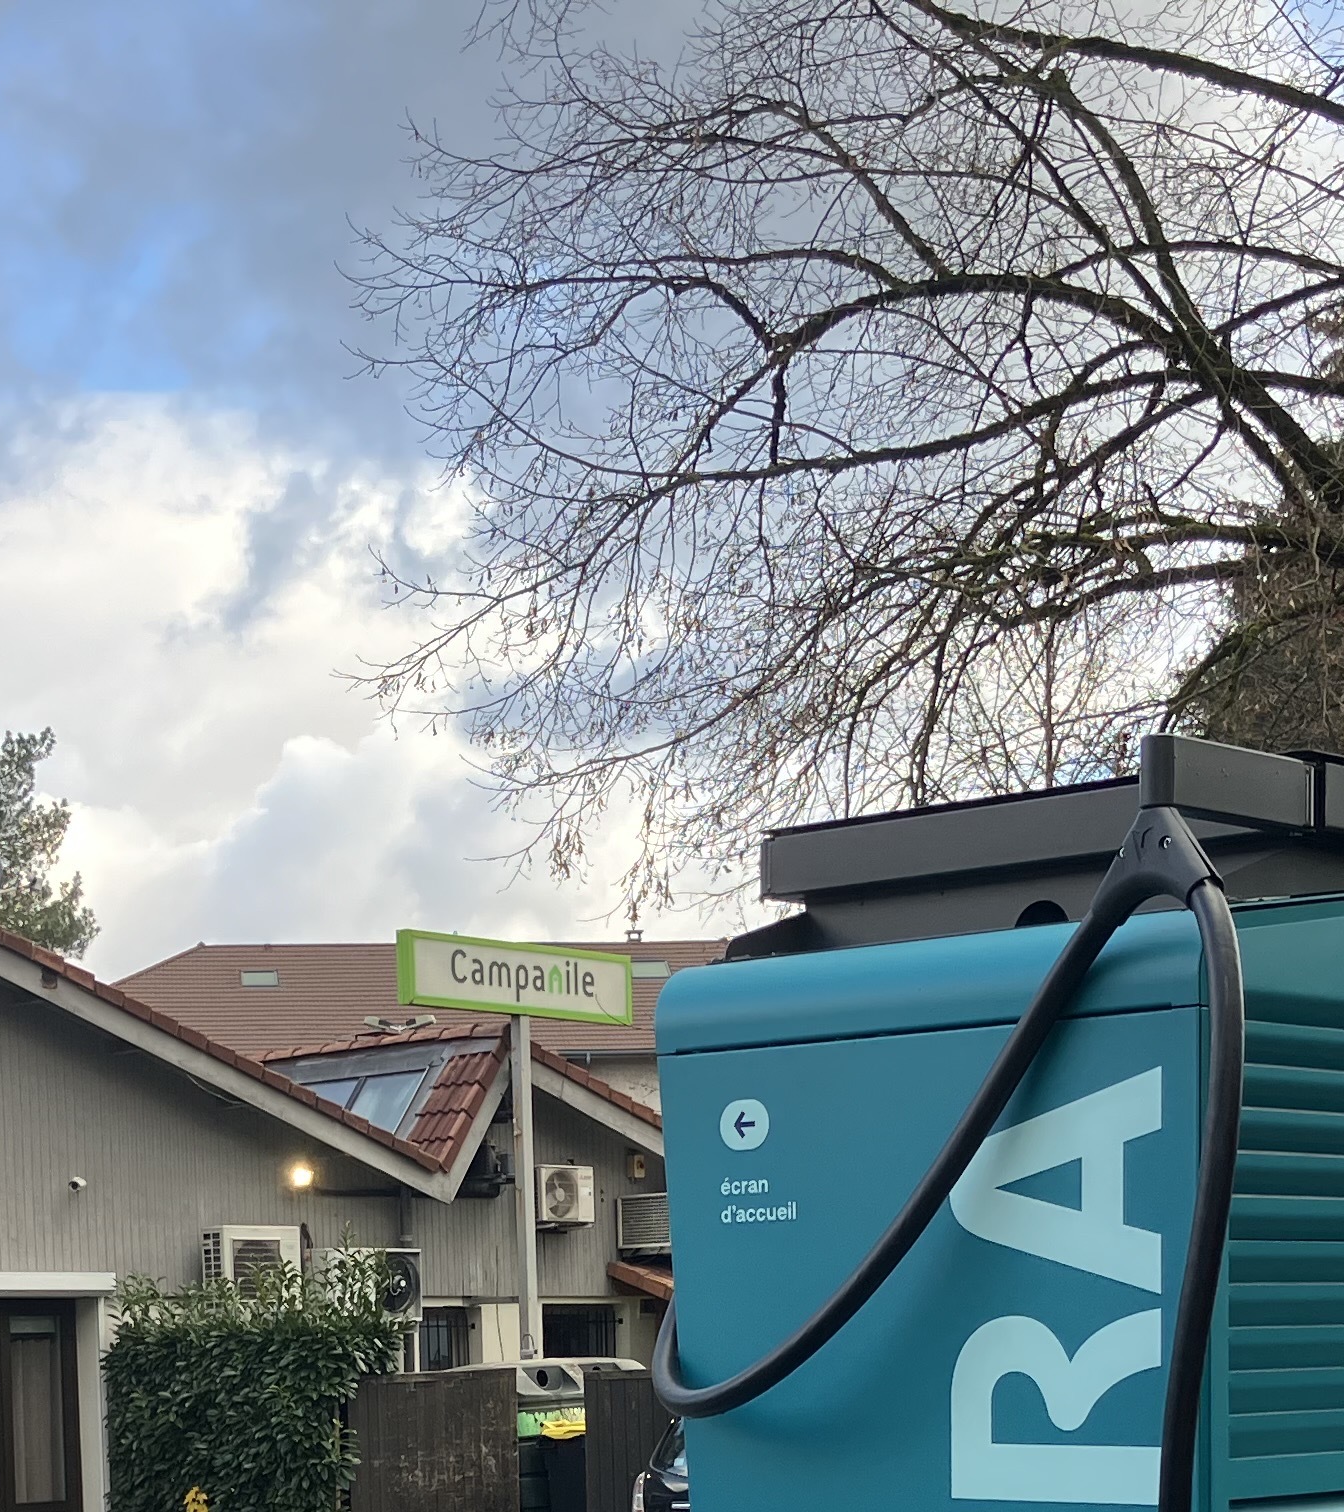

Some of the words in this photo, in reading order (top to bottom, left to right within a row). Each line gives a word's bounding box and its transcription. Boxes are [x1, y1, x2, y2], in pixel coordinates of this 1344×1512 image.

[451, 949, 595, 1003] Campanile
[720, 1177, 769, 1196] écran
[720, 1201, 797, 1224] d'accueil
